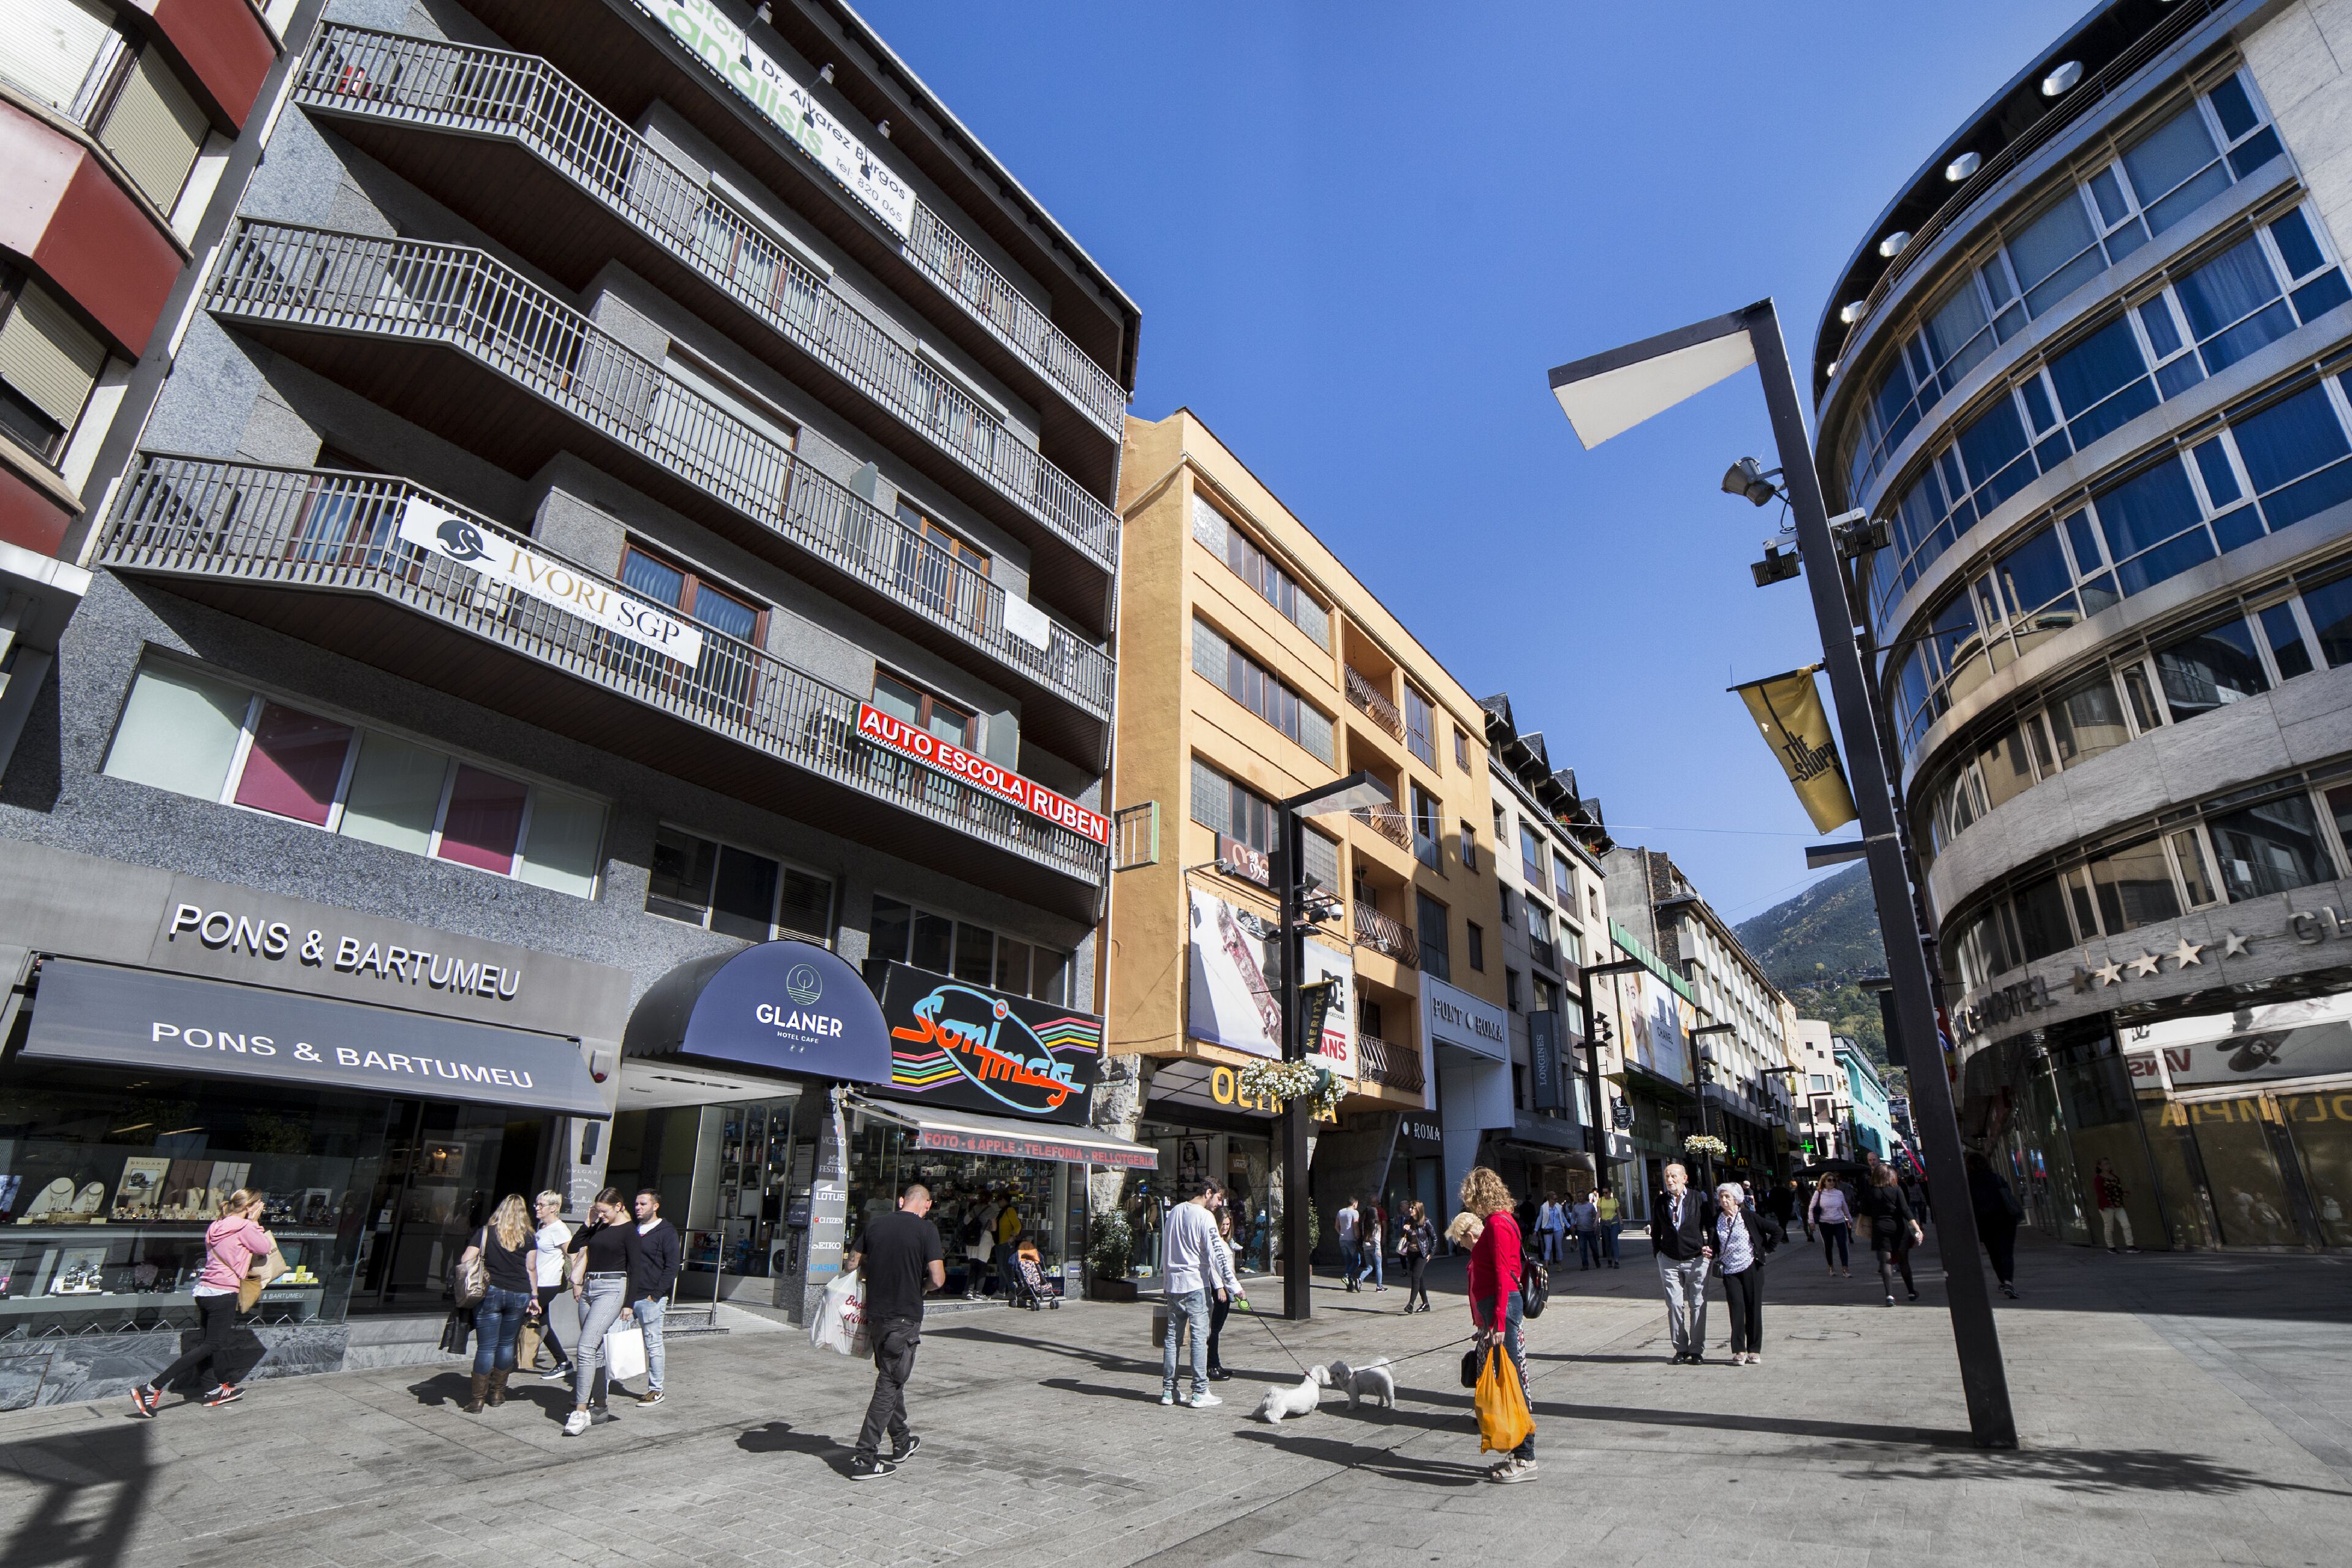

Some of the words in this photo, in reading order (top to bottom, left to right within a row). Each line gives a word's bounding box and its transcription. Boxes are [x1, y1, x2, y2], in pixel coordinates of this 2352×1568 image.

[761, 59, 783, 89] Dr.
[856, 145, 907, 201] Burgos
[835, 156, 853, 178] Tel:
[858, 178, 880, 205] 820
[882, 198, 903, 223] 065
[507, 548, 612, 616] IVORI
[617, 601, 681, 646] SGP
[559, 600, 603, 624] GESTORA
[608, 622, 619, 631] DE
[1782, 730, 1813, 764] THE
[863, 710, 933, 756] AUTO
[938, 747, 1024, 801] ESCOLA
[1033, 790, 1104, 842] RUBEN
[168, 903, 290, 956] PONS
[301, 929, 325, 962] &
[335, 935, 522, 997] BARTUMEU
[1433, 997, 1463, 1025] PUNT
[1475, 1015, 1504, 1041] ROMA
[1978, 975, 2059, 1028] HOTEL
[755, 1003, 843, 1038] GLANER
[777, 1031, 799, 1041] HOTEL
[801, 1035, 819, 1044] CAFE
[1656, 1026, 1673, 1045] CHANEL
[151, 1022, 277, 1057] PONS
[293, 1042, 323, 1063] &
[335, 1046, 534, 1089] BARTUMEU
[1319, 1035, 1347, 1061] ANS
[1536, 1034, 1548, 1086] LONGINES
[821, 1136, 850, 1147] VICEROY
[924, 1132, 959, 1148] FOTO
[977, 1139, 1016, 1153] APPLE
[1024, 1143, 1084, 1161] TELEFONIA
[1091, 1151, 1155, 1167] RELLOTGERIA
[1413, 1122, 1441, 1142] ROMA
[819, 1165, 848, 1175] FESTINA
[1232, 1158, 1246, 1169] VANS
[816, 1191, 846, 1201] LOTUS
[1208, 1227, 1234, 1285] CALIFORNIA
